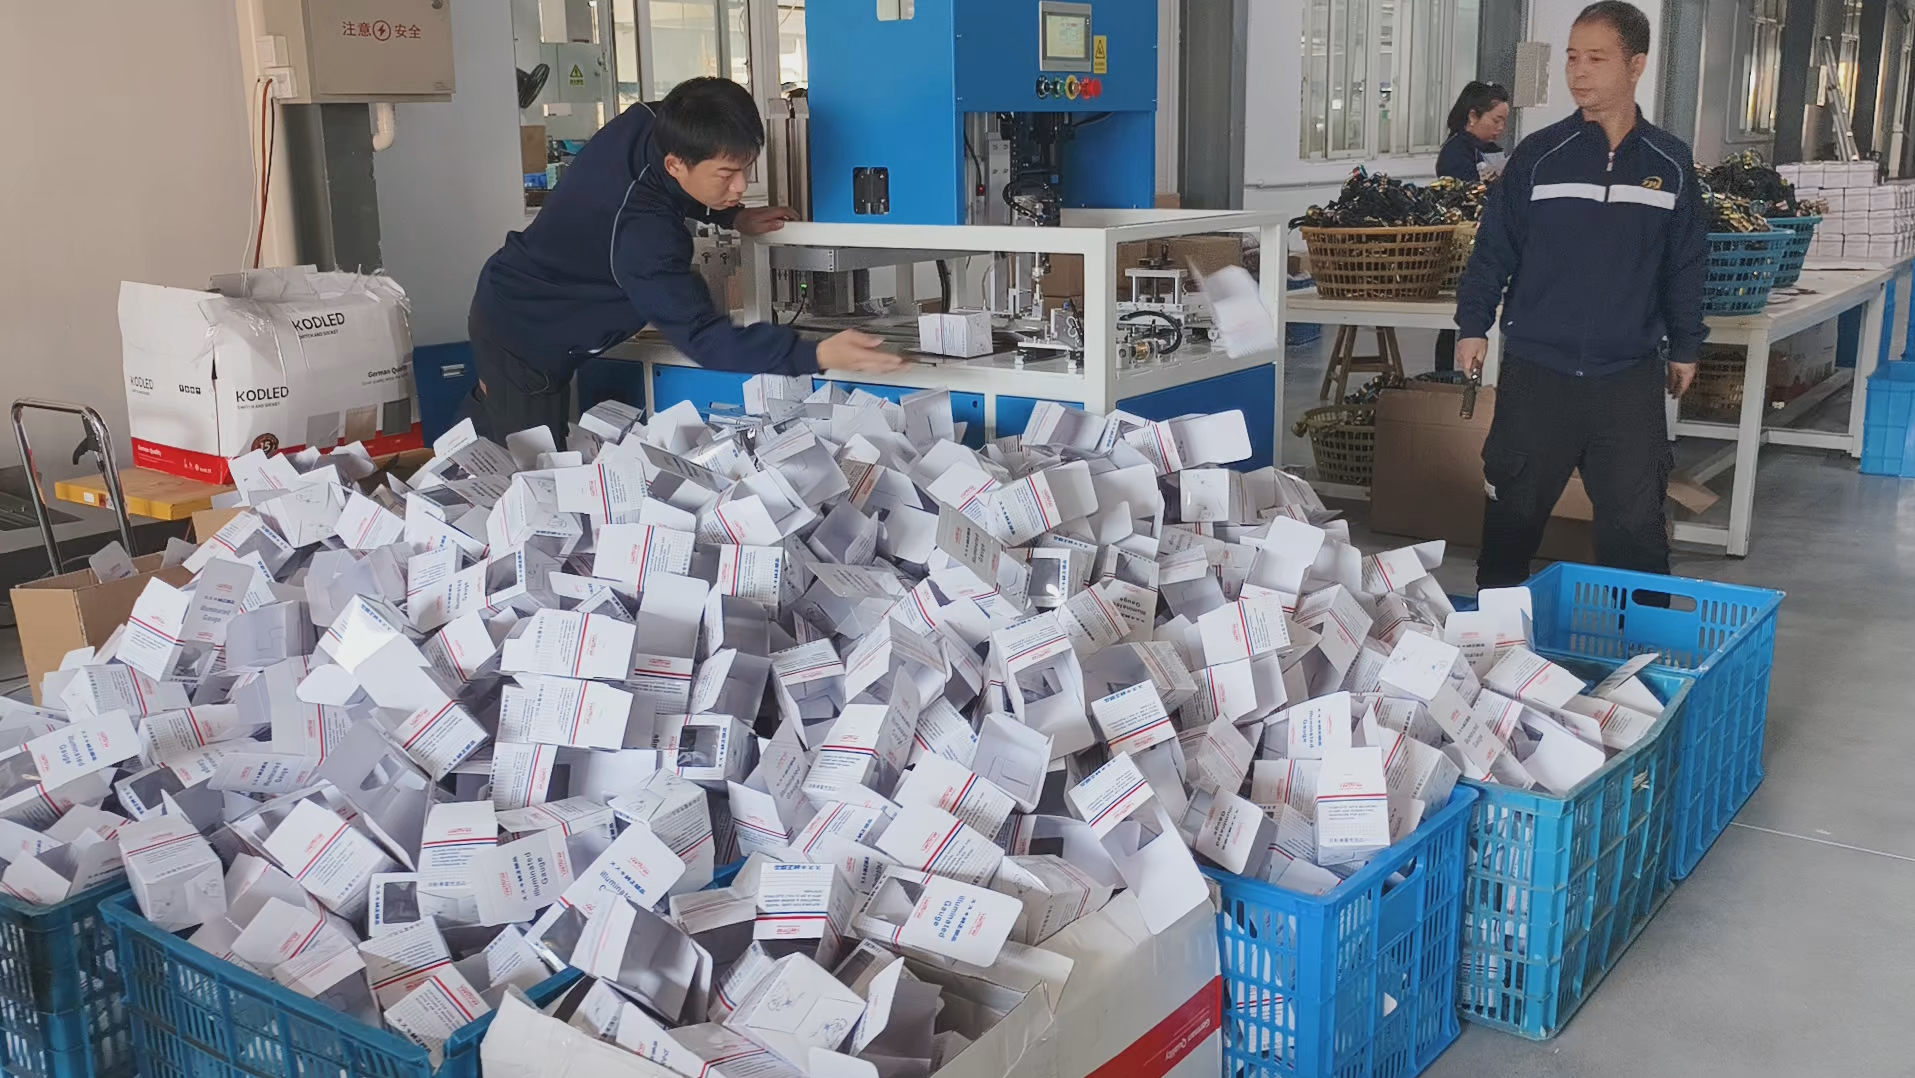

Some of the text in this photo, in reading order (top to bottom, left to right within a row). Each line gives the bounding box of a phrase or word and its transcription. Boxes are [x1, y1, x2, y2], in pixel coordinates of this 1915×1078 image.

[342, 21, 421, 39] 注意 安全
[291, 312, 345, 331] KODLED
[368, 369, 391, 378] German
[236, 386, 289, 402] KODLED
[524, 851, 541, 897] Illuminated
[537, 856, 549, 885] Gauge
[600, 869, 632, 899] Illuminate
[933, 900, 952, 927] Gauge
[937, 895, 966, 939] Illuminated
[1164, 1018, 1211, 1063] German Quality
